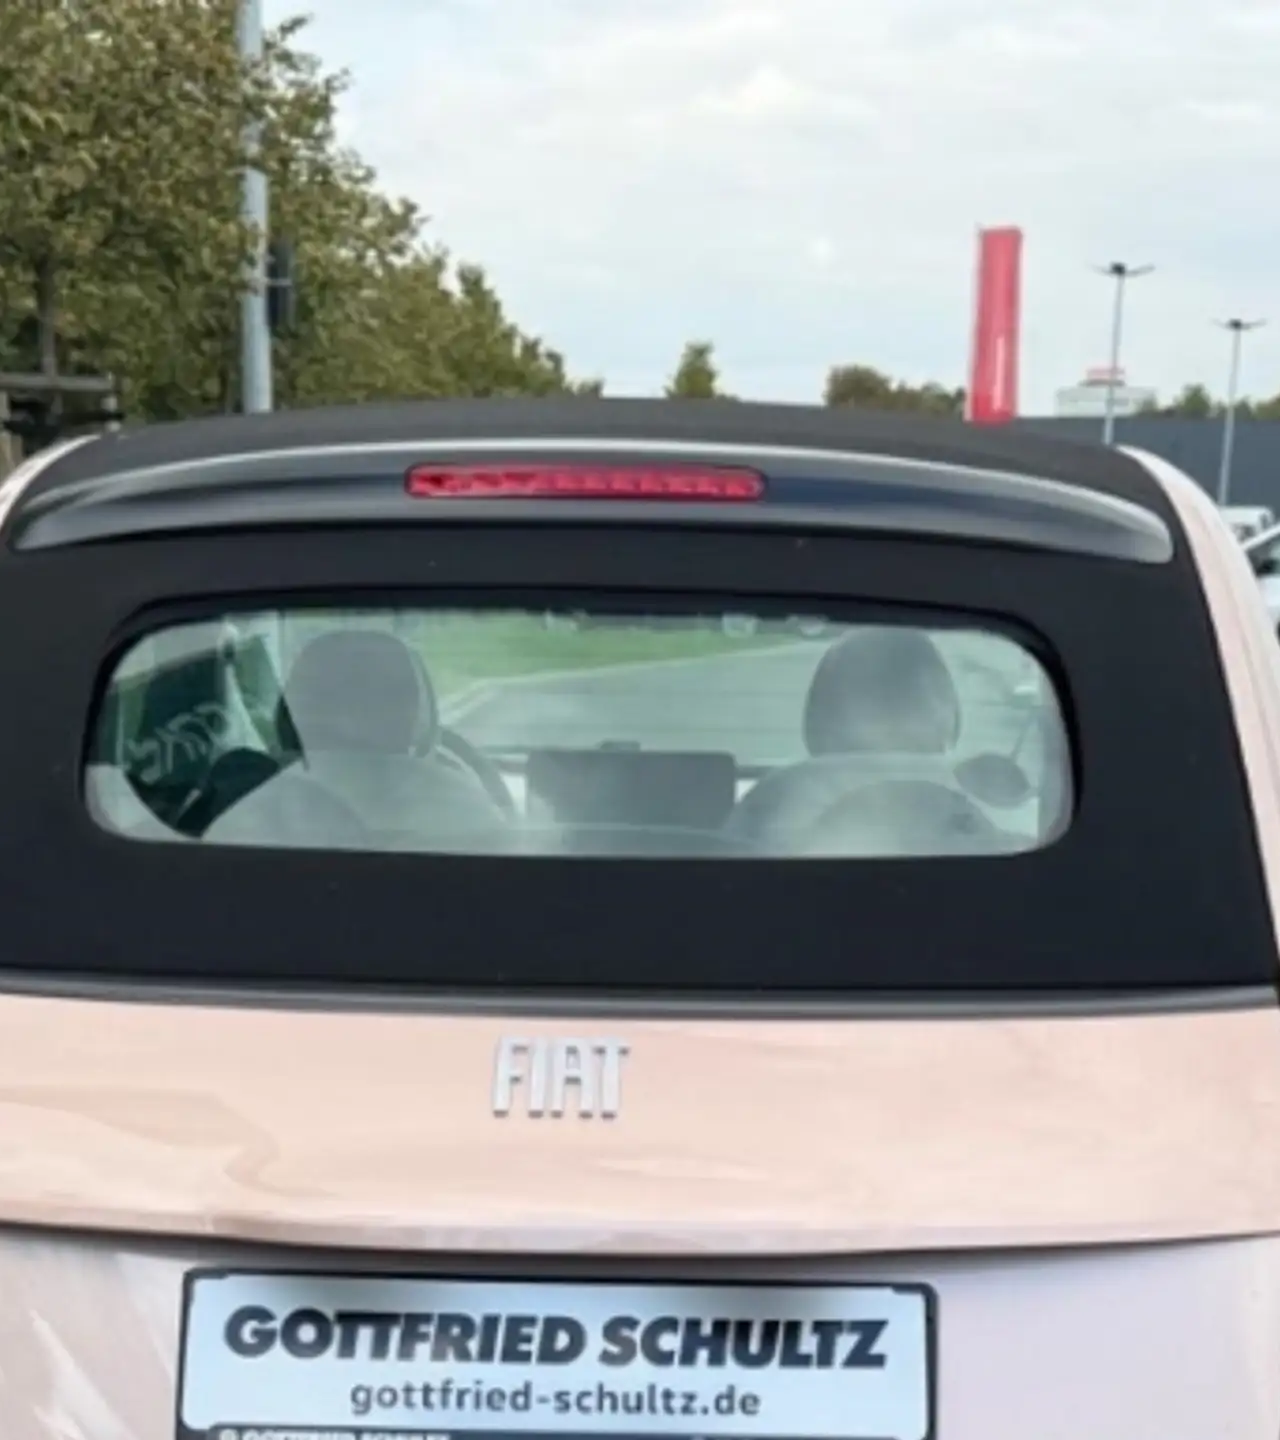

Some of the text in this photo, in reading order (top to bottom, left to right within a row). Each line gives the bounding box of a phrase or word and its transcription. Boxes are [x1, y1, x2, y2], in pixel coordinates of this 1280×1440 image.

[492, 1038, 630, 1119] FIAT
[225, 1305, 889, 1370] GOTTFRIED SCHULTZ
[350, 1380, 762, 1416] gottfried-schultz.de
